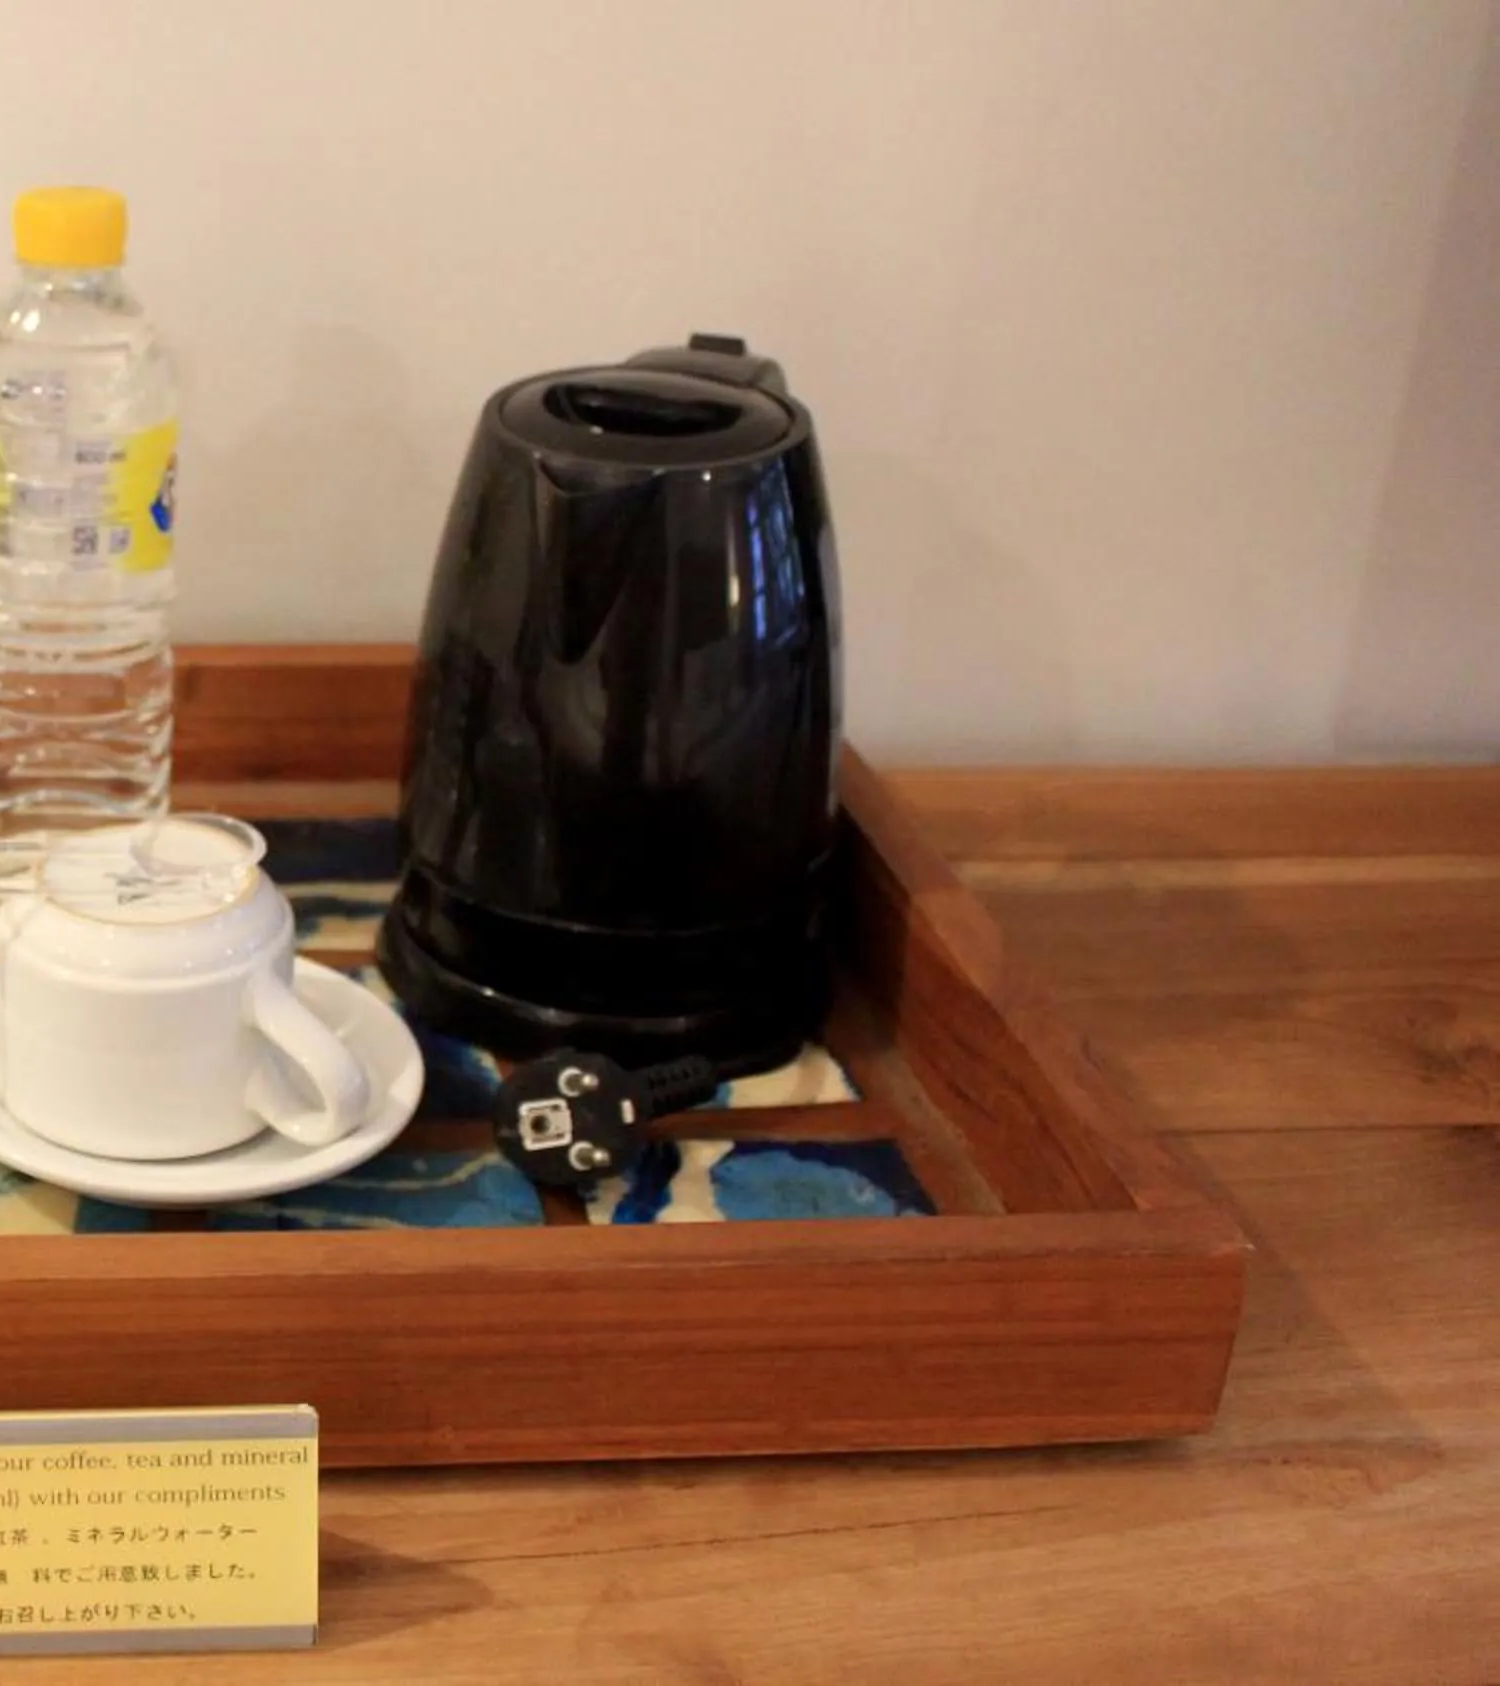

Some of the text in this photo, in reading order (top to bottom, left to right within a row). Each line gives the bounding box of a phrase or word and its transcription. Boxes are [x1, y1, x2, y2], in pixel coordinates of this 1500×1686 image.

[126, 1453, 162, 1469] tea
[169, 1449, 213, 1467] and
[221, 1446, 309, 1466] mineral
[29, 1487, 80, 1506] with
[87, 1490, 125, 1505] our
[134, 1484, 286, 1507] compliments
